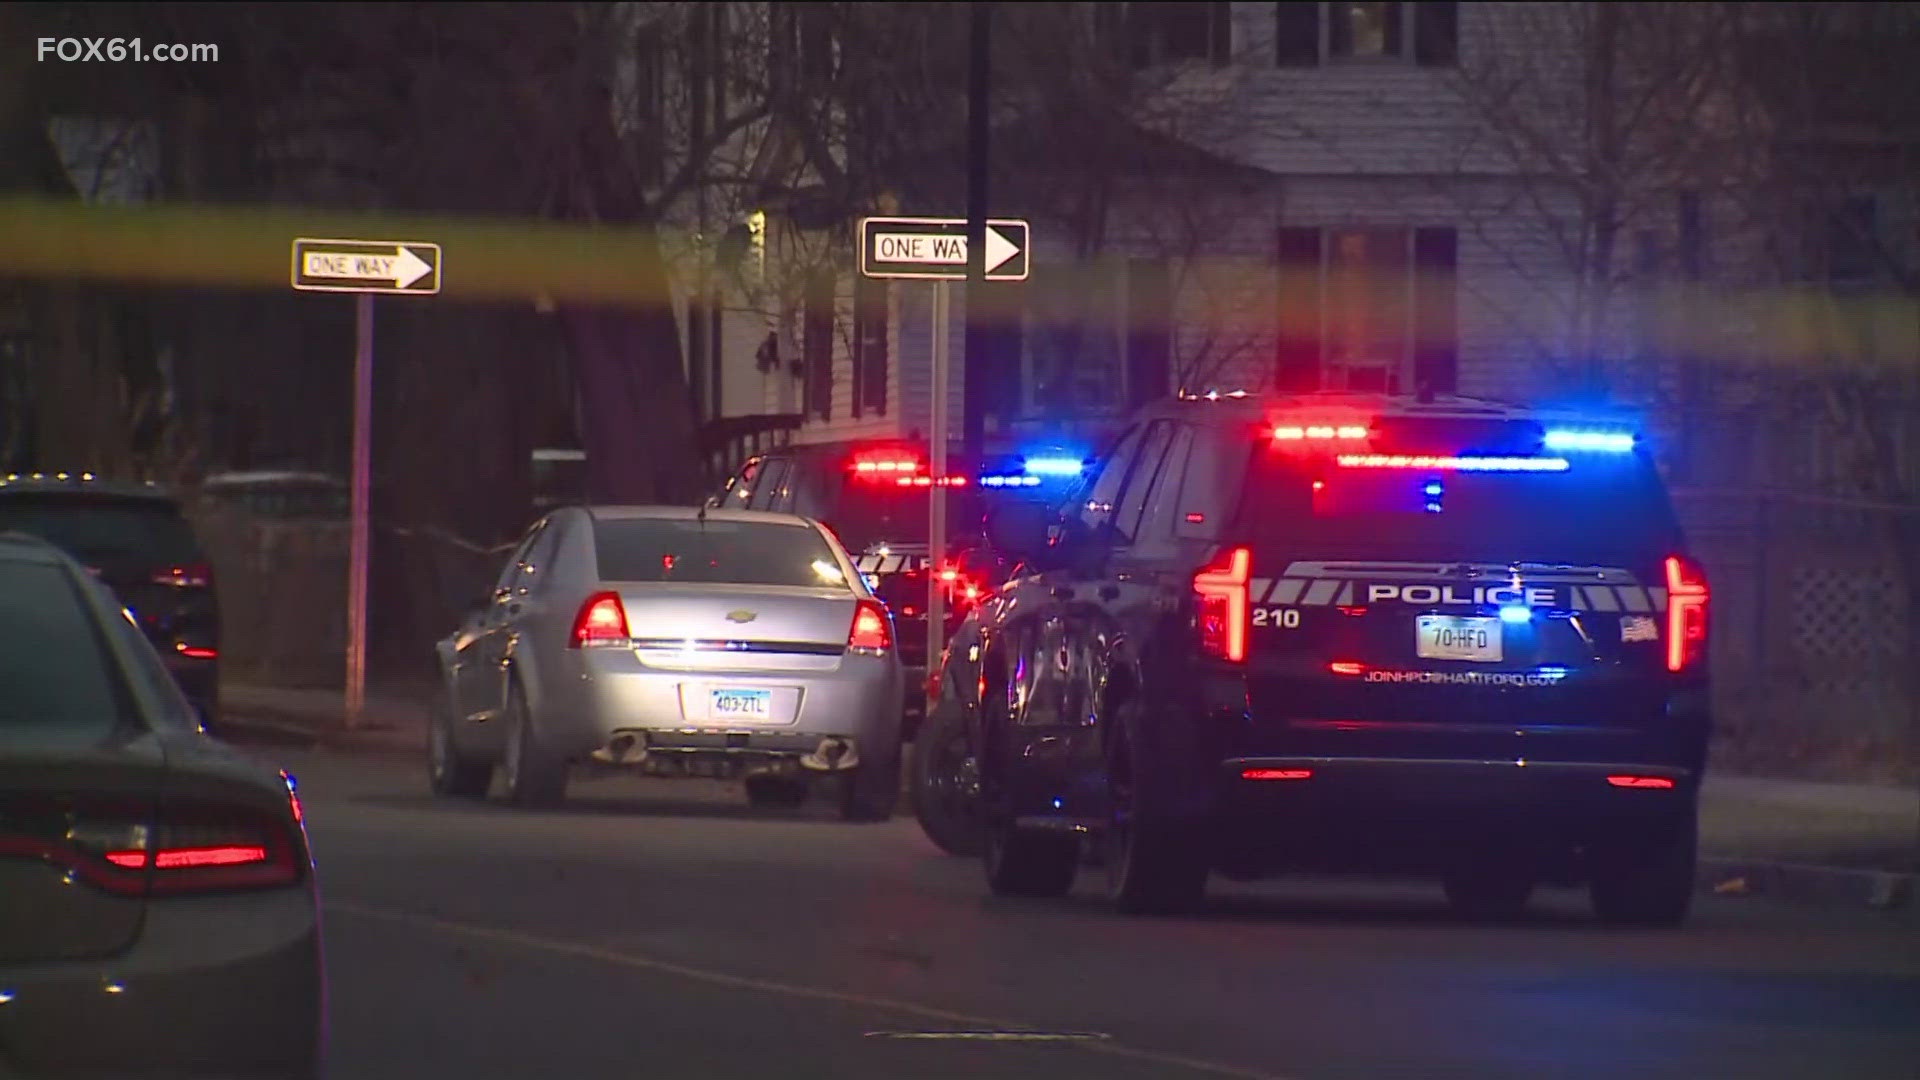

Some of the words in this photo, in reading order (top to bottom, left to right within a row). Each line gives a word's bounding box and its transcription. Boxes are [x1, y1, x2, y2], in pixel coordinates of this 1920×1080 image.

[881, 237, 923, 258] ONE
[933, 238, 968, 259] WA
[310, 256, 347, 274] ONE
[354, 257, 394, 275] WAY
[1368, 584, 1556, 606] POLICE
[1252, 608, 1299, 628] 210
[716, 696, 764, 712] 403-ZTL
